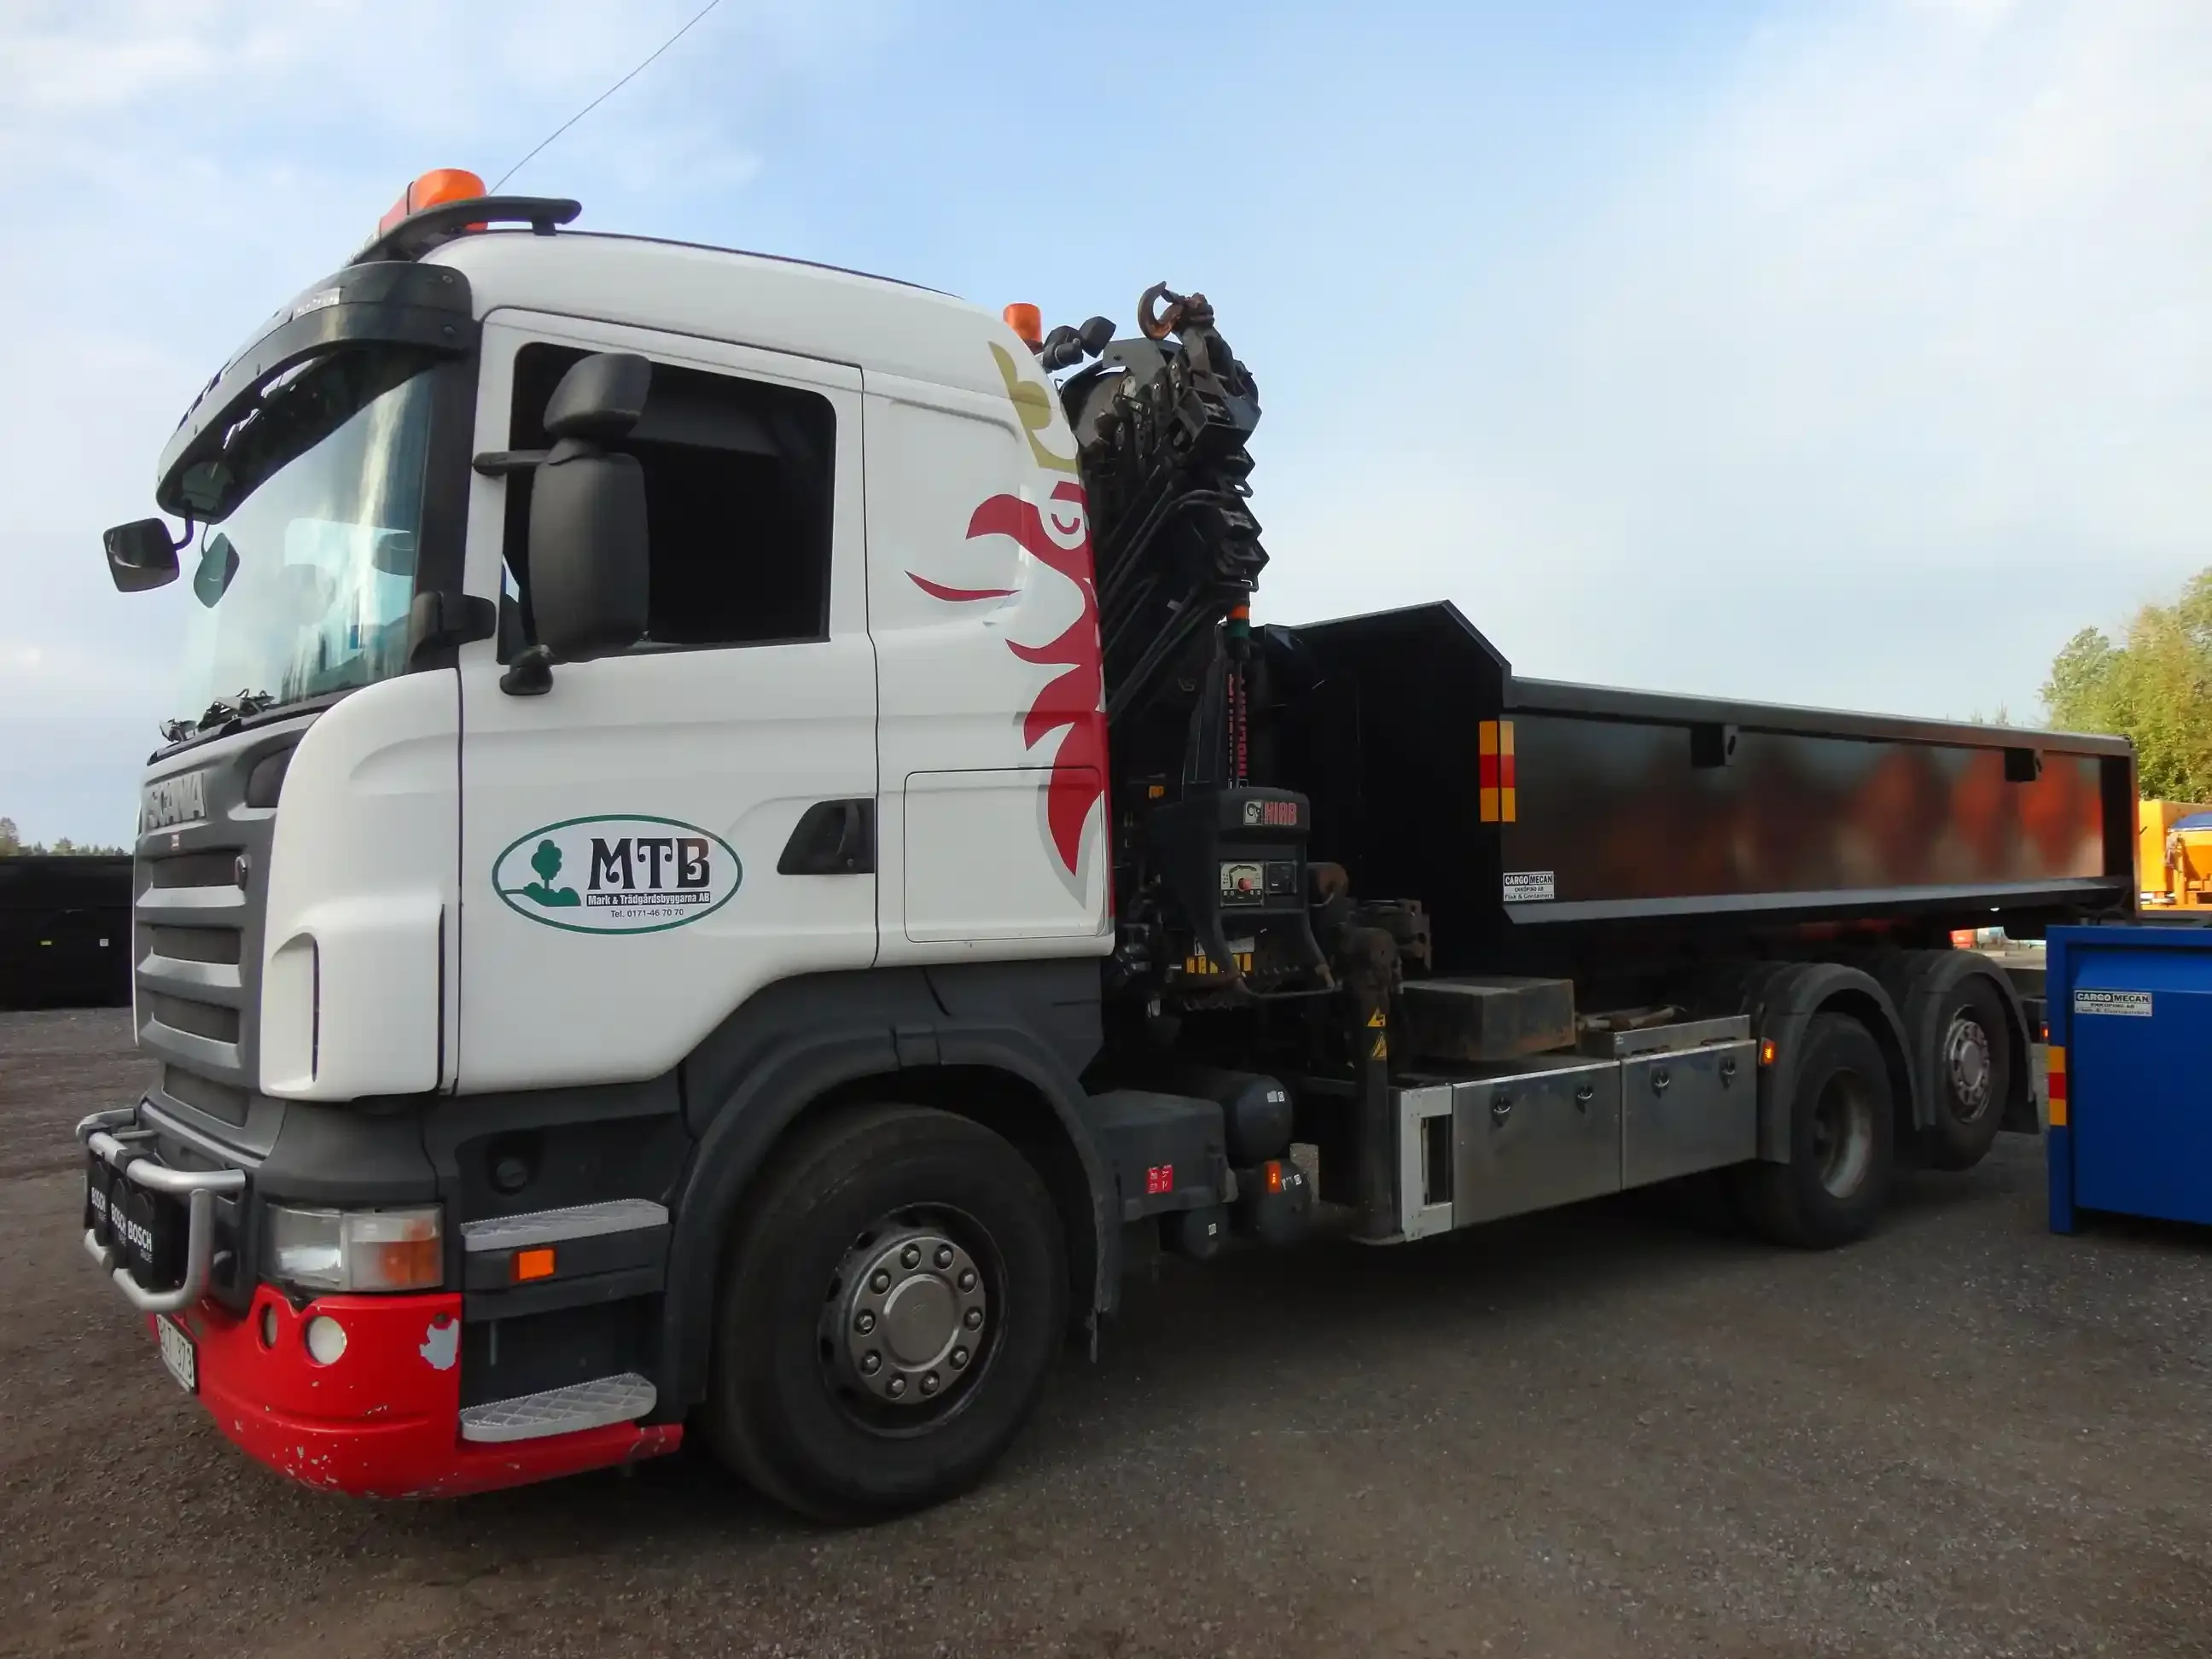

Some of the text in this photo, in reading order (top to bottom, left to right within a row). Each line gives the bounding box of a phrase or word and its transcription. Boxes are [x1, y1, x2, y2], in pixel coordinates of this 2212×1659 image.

[1265, 801, 1297, 826] HIAB
[587, 837, 711, 890] MTB
[1505, 876, 1528, 885] CARGO
[587, 894, 611, 905] Mark
[612, 895, 619, 905] &
[698, 892, 710, 903] AB
[610, 907, 684, 918] Tel. 0171-46 70 70
[2077, 992, 2149, 1004] CARGO MECAN
[127, 1220, 153, 1253] BOSCH
